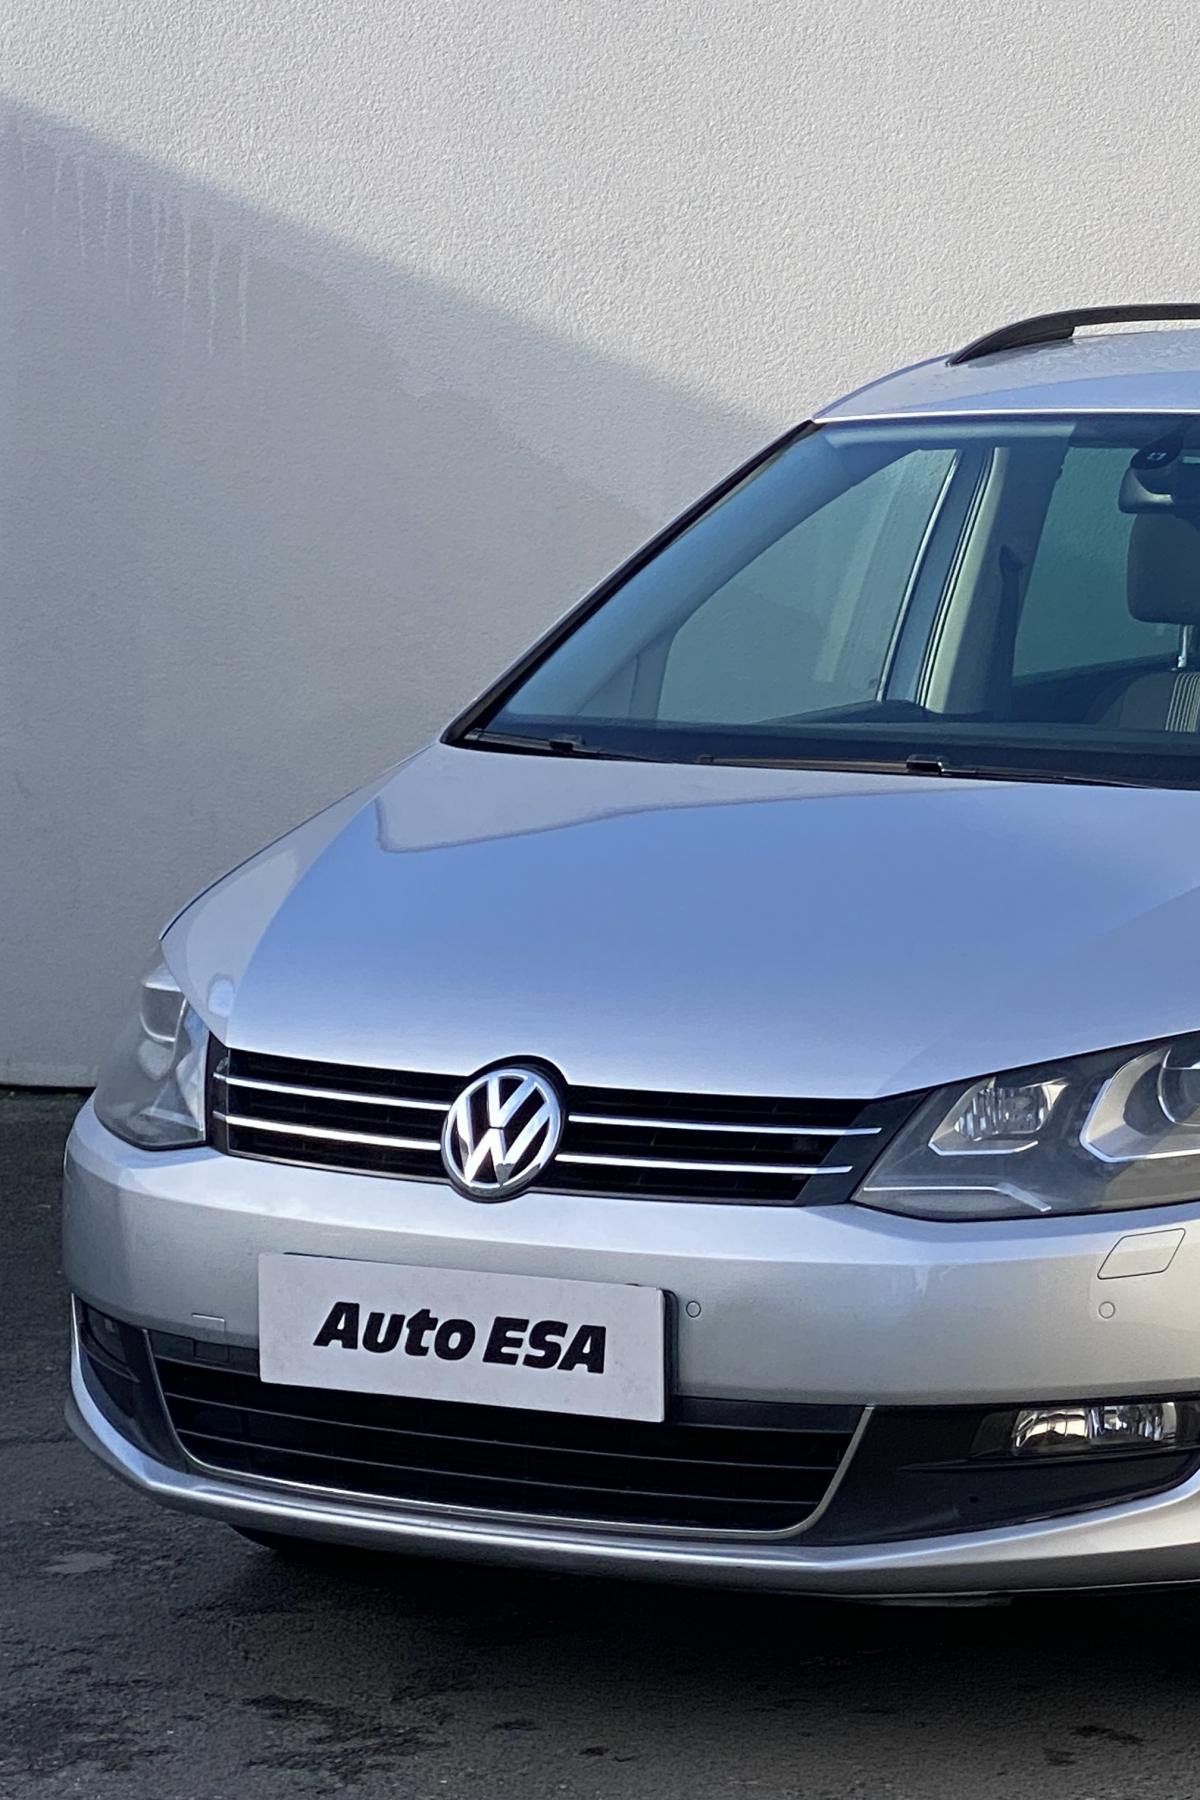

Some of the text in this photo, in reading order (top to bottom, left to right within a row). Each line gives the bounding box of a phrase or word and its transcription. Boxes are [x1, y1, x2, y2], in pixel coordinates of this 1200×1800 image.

[443, 1068, 561, 1197] VW
[313, 1301, 607, 1374] Auto ESA
